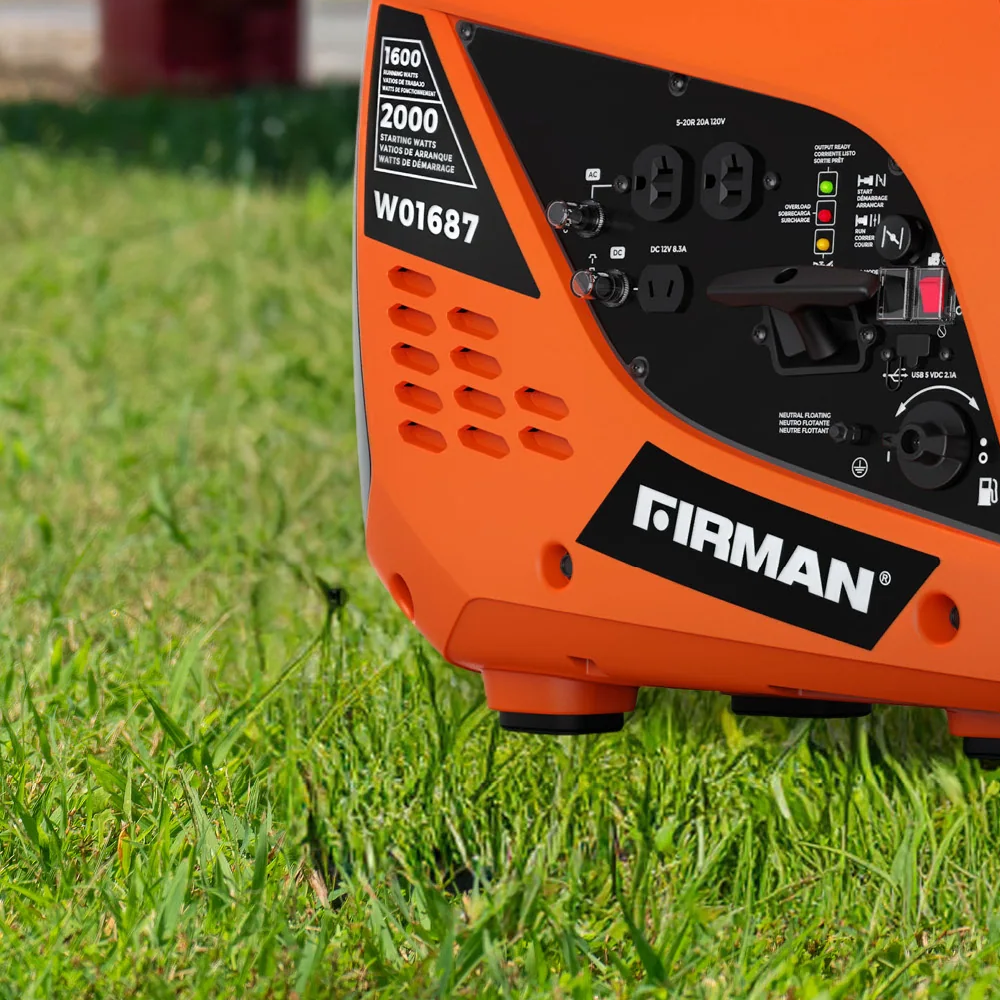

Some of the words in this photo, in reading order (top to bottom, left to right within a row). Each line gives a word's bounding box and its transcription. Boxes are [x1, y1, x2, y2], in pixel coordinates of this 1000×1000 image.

[384, 45, 421, 68] 1600
[403, 71, 418, 79] WATTS
[405, 80, 425, 88] TRABAJO
[379, 102, 438, 134] 2000
[676, 118, 695, 126] 5-20R
[696, 117, 710, 126] 20A
[710, 117, 726, 125] 120V
[380, 133, 412, 145] STARTING
[413, 138, 437, 149] WATTS
[379, 143, 403, 155] VATIOS
[403, 147, 413, 156] DE
[414, 149, 453, 163] ARRANQUE
[378, 154, 401, 166] WATTS
[401, 158, 411, 167] DE
[411, 159, 455, 174] DÉMARRAGE
[588, 171, 598, 179] AC
[373, 189, 480, 244] W01687
[650, 245, 660, 253] DC
[661, 245, 672, 253] 12V
[672, 245, 687, 253] 8.3A
[911, 371, 926, 379] USB
[925, 371, 929, 379] 5
[930, 371, 944, 379] VDC
[944, 371, 957, 379] 2.1A
[778, 411, 804, 419] NEUTRAL
[804, 411, 831, 419] FLOATING
[802, 419, 830, 427] FLOTANTE
[632, 483, 876, 615] FIRMAN
